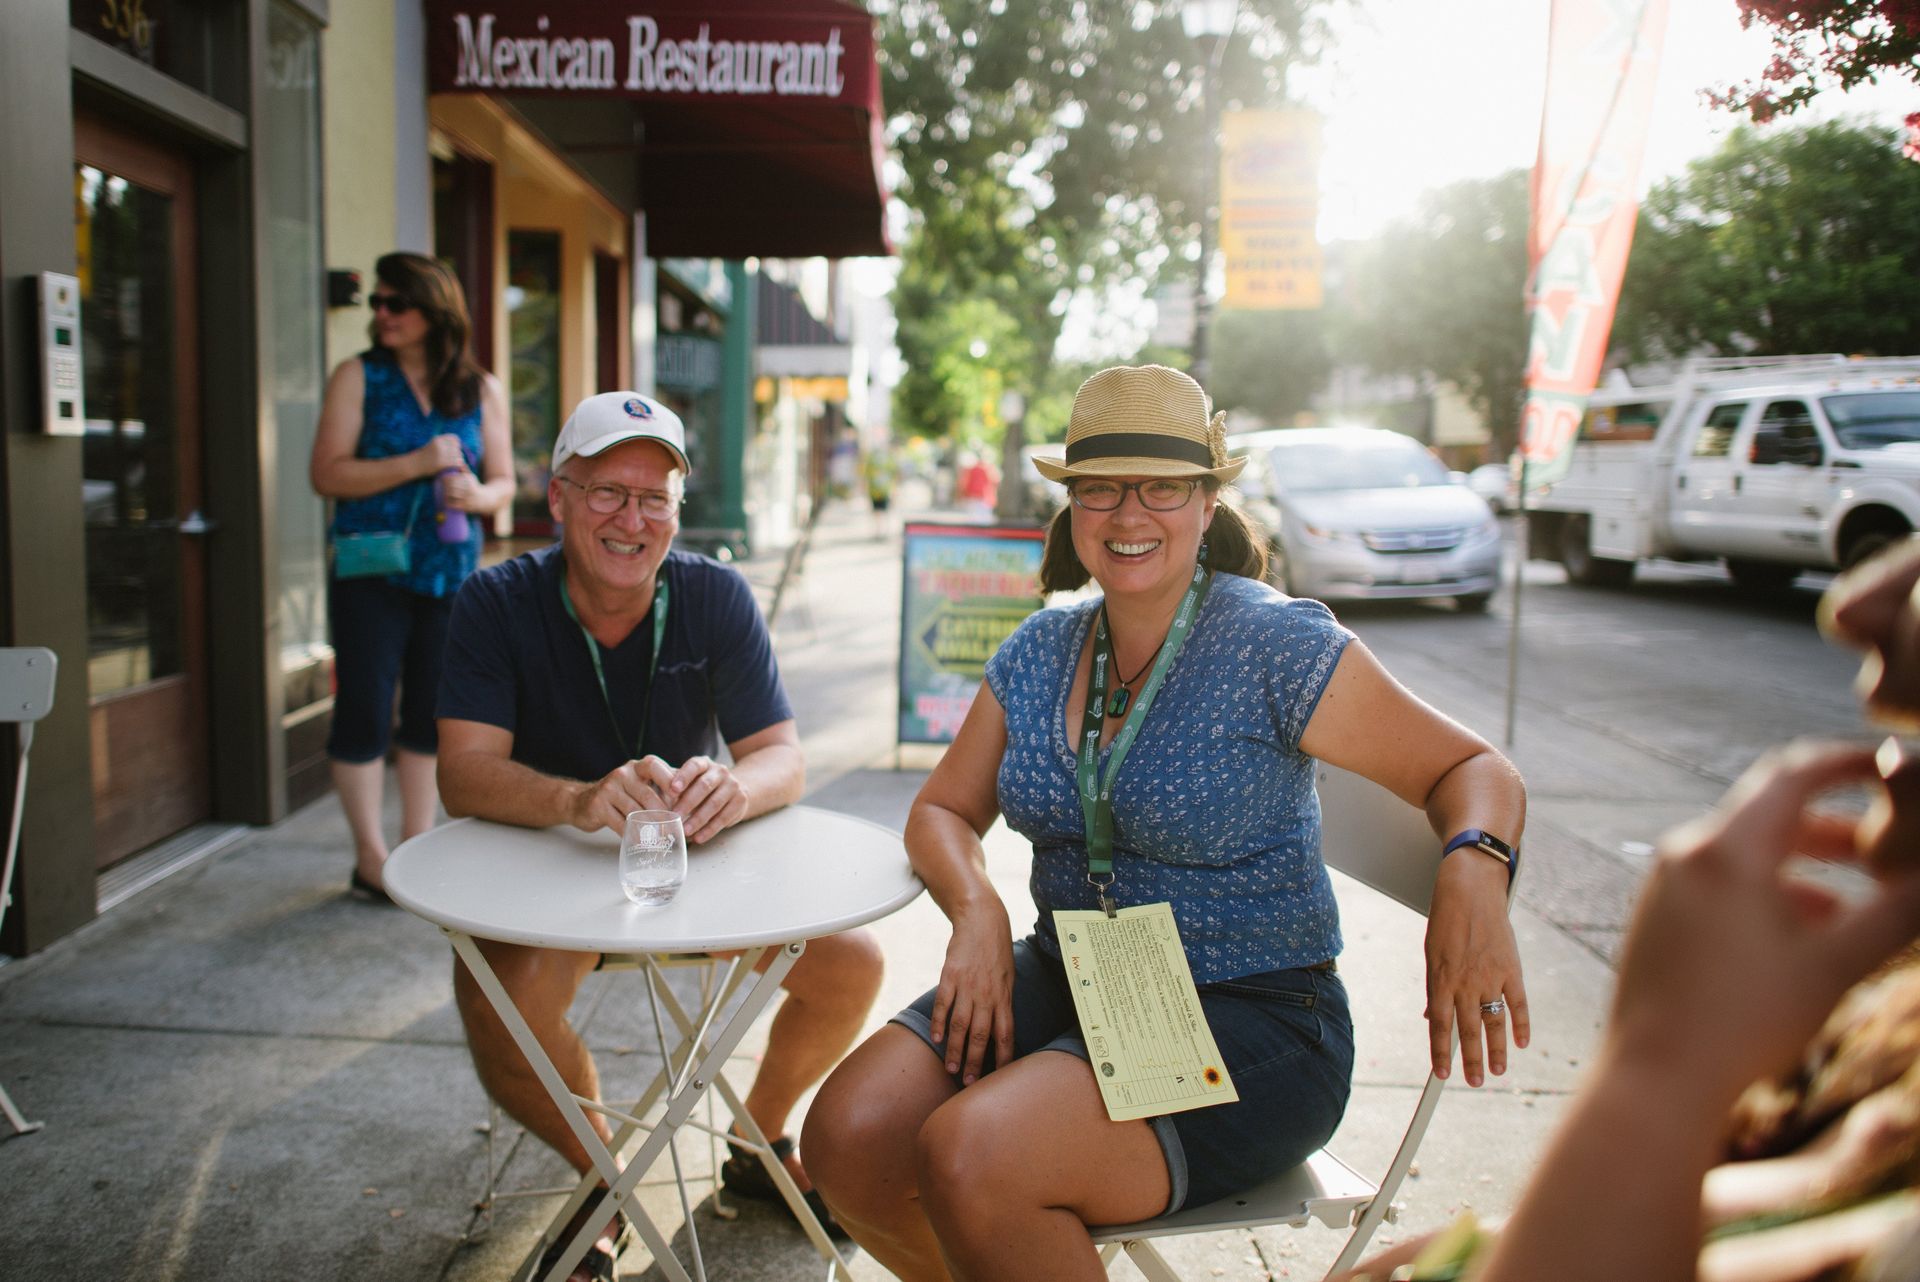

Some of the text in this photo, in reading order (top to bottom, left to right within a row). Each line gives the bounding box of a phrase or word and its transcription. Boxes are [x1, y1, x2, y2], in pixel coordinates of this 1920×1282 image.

[453, 13, 845, 97] Mexican Restaurant
[1071, 956, 1082, 971] kw
